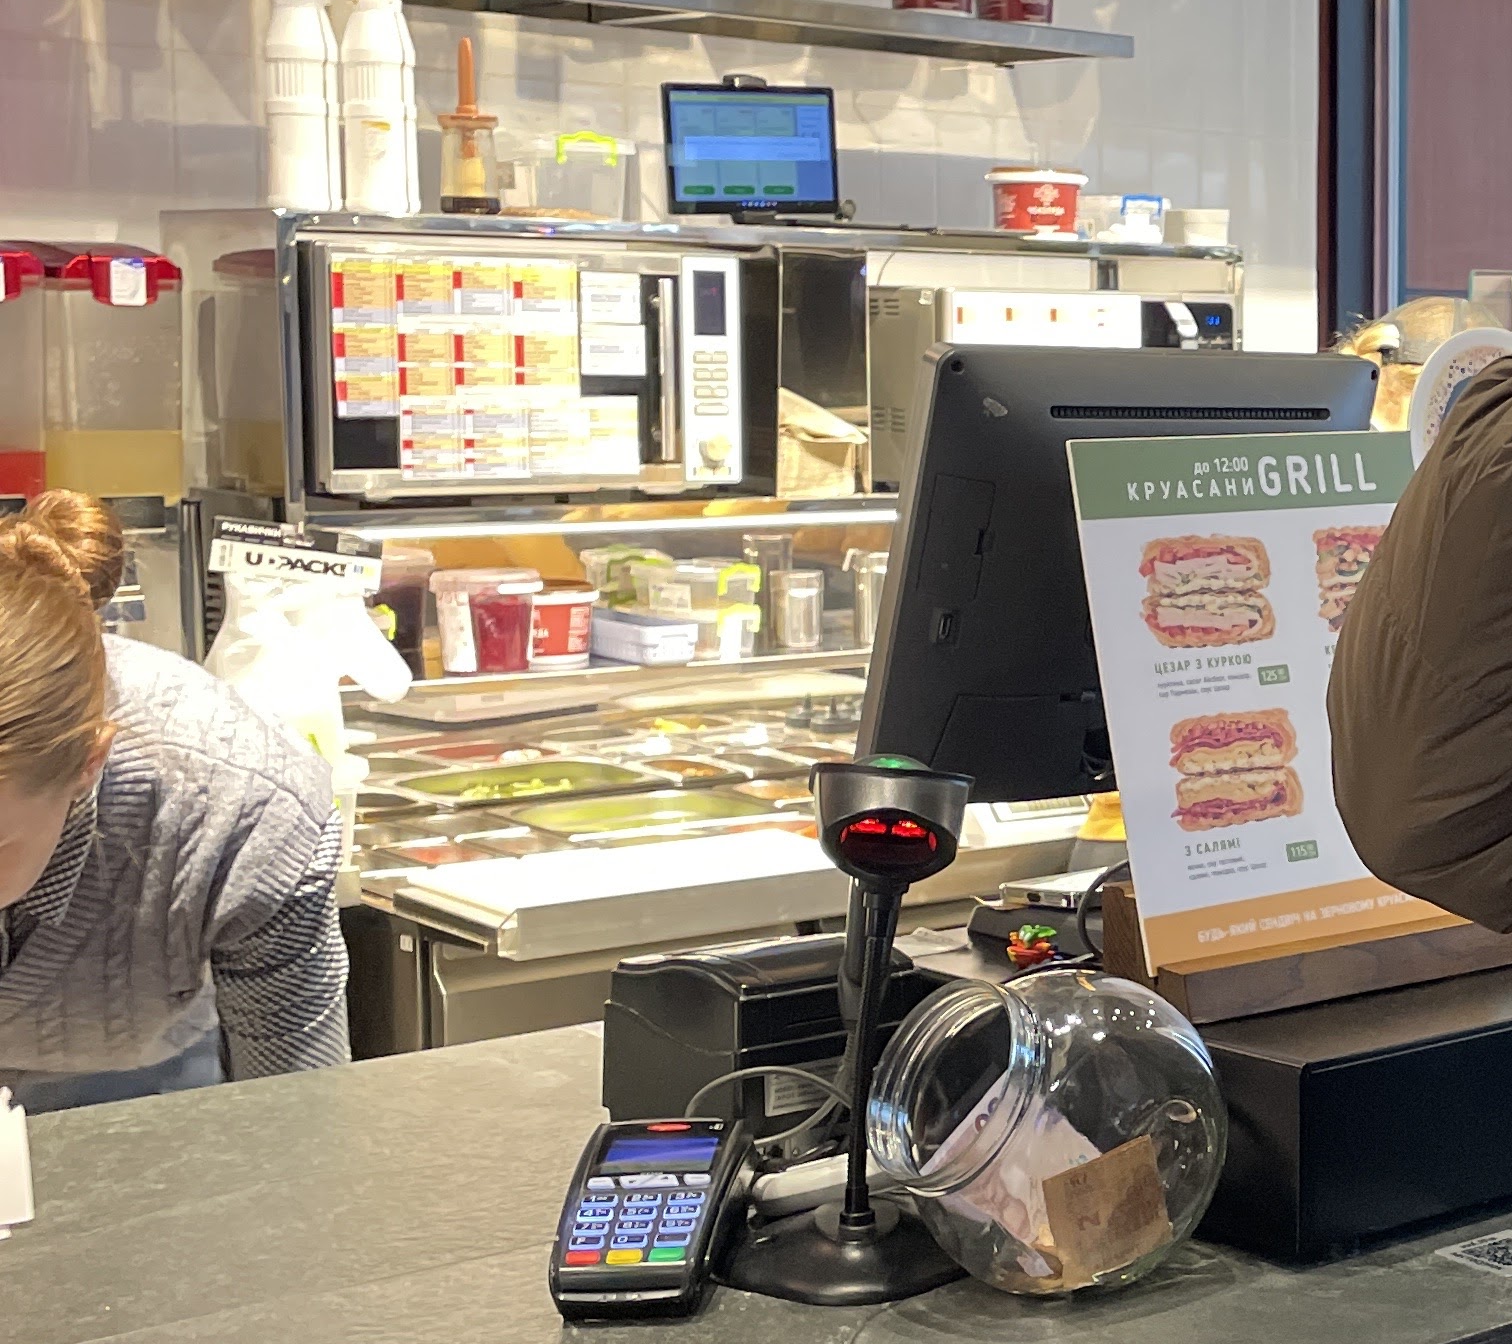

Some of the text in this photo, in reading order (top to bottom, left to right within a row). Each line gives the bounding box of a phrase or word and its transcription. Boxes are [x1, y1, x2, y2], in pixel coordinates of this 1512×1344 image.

[1194, 456, 1249, 476] до 12:00
[1128, 453, 1377, 502] КРУАСАНИ GRILL
[1154, 658, 1191, 675] ЦЕЗАР
[1207, 653, 1252, 669] КУРКОЮ
[1196, 838, 1240, 855] САЛЯМІ
